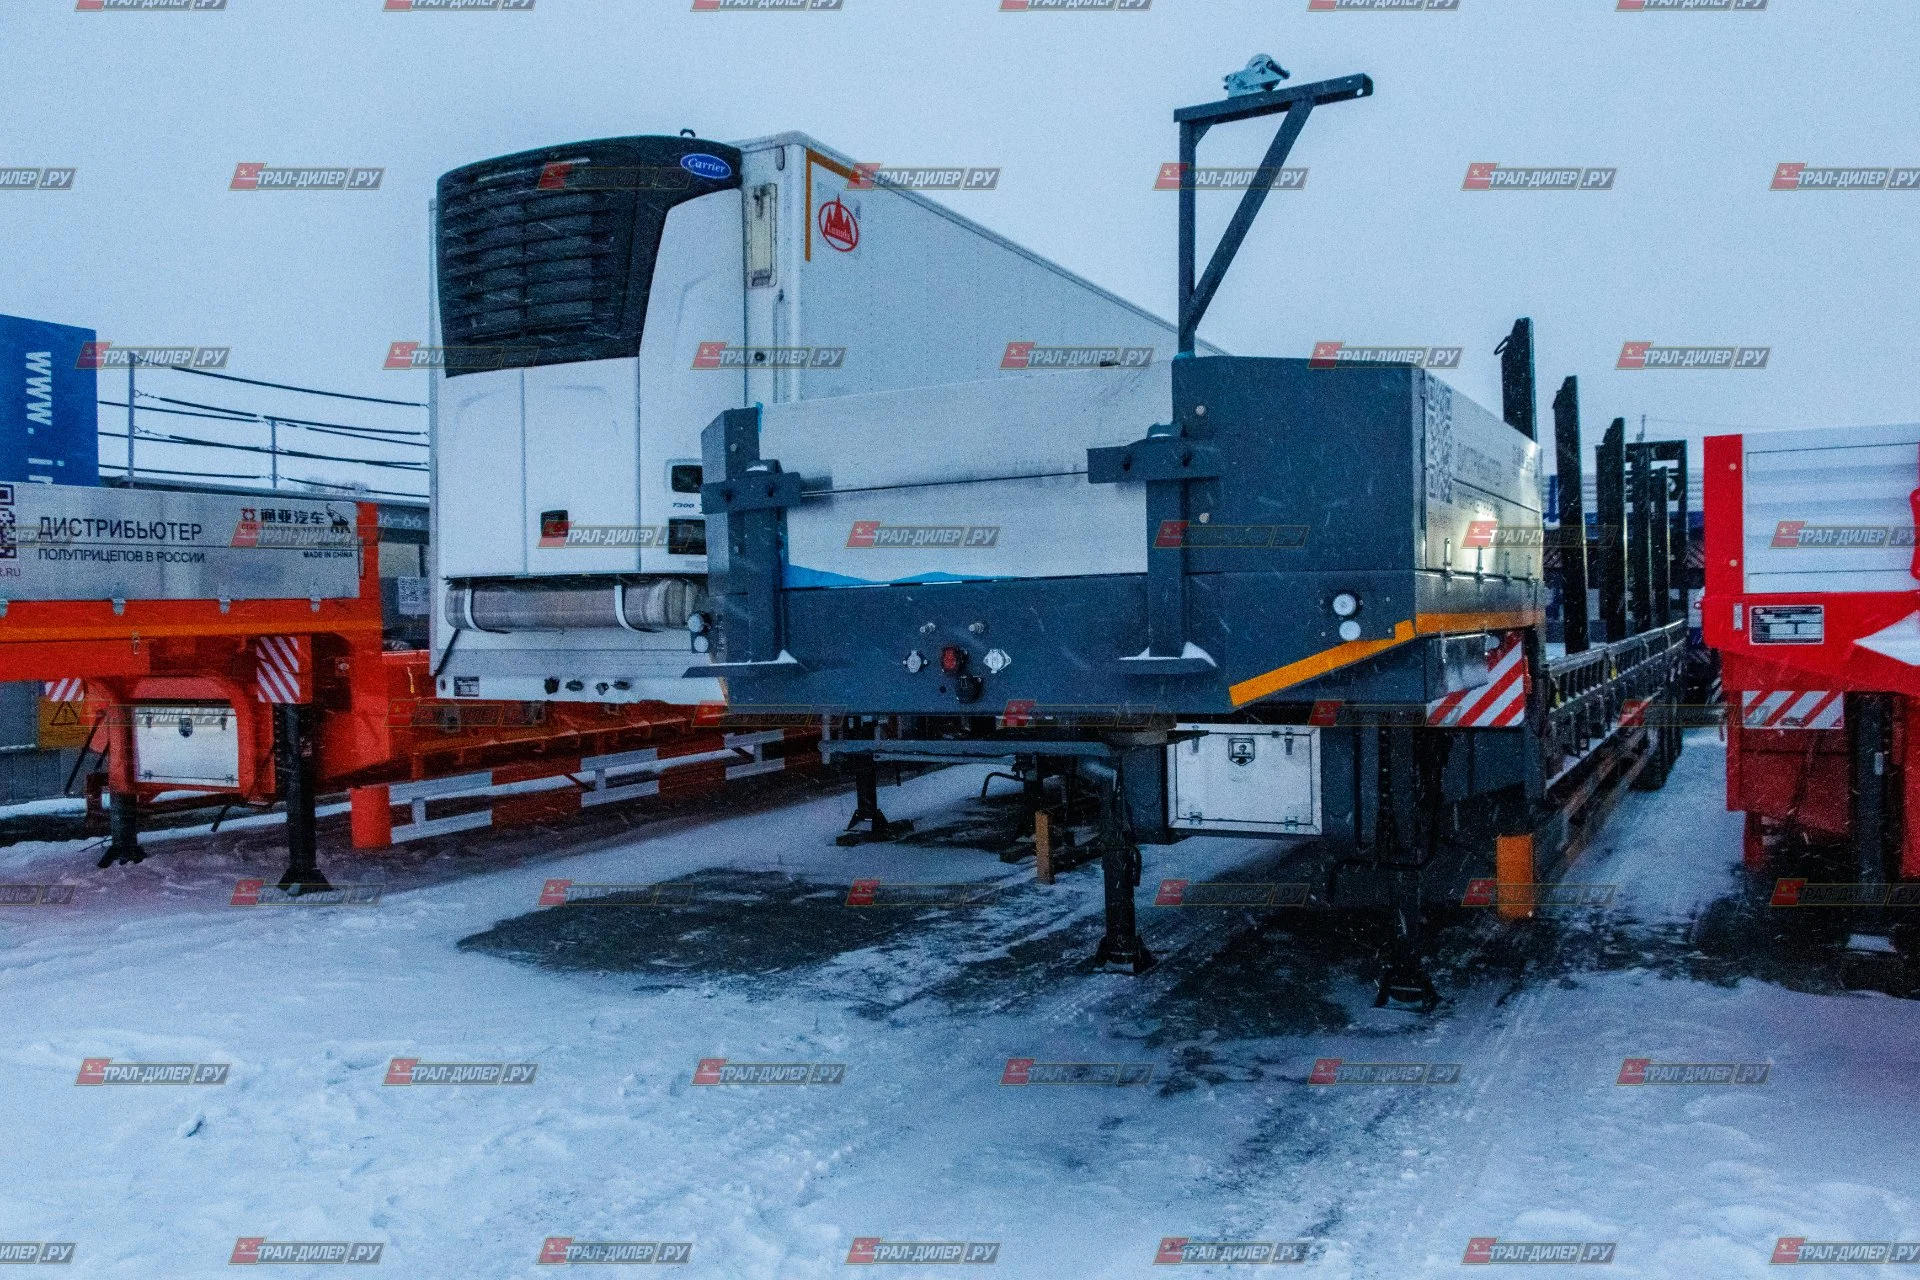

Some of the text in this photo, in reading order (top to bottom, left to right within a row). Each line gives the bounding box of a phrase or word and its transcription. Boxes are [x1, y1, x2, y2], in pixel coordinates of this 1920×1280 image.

[688, 157, 726, 173] Carrier
[260, 508, 325, 524] 通亚汽车
[39, 516, 202, 541] ДИСТРИБЬЮТЕР
[38, 548, 205, 564] ПОЛУПРИЦЕПОВ В РОССИИ
